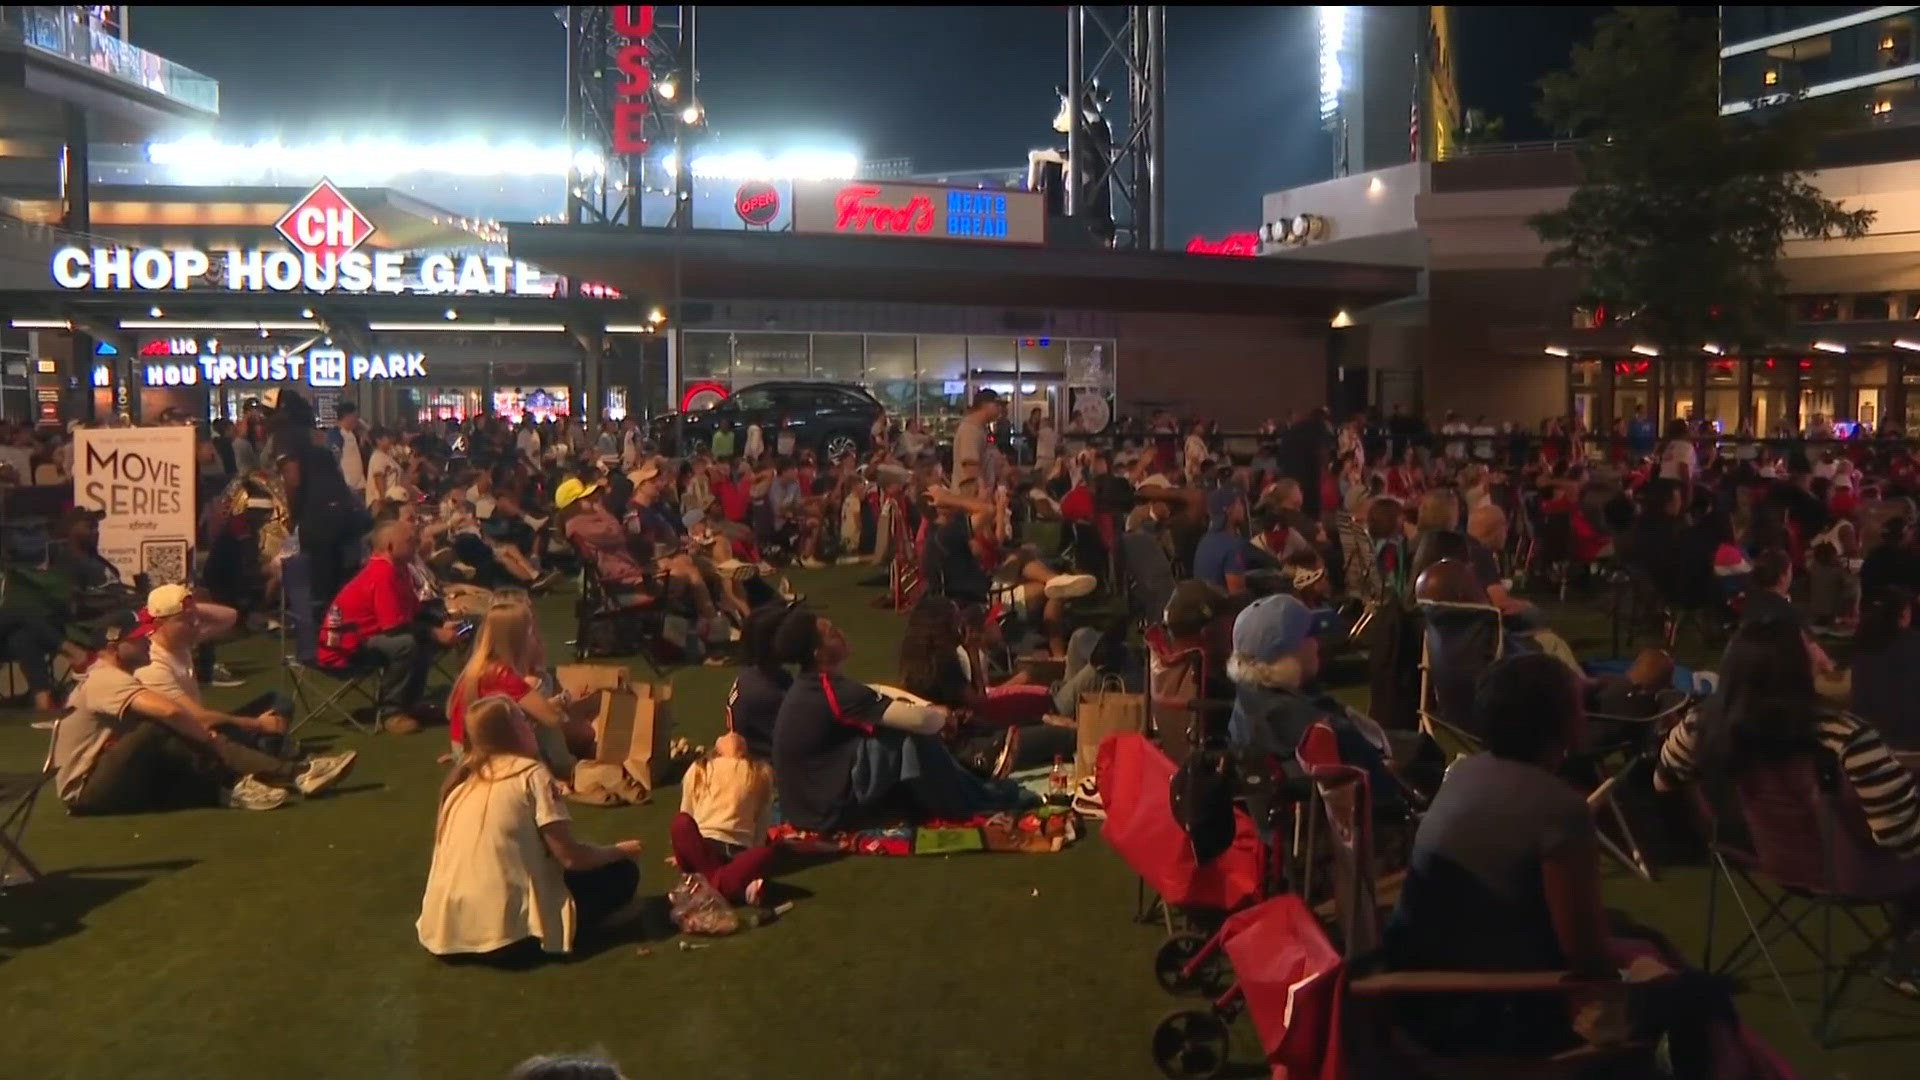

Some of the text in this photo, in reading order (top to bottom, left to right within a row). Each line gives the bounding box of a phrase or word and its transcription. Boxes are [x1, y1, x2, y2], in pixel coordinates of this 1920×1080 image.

[742, 191, 775, 214] OPEN
[834, 183, 936, 236] Fred's
[947, 190, 992, 214] MEAT
[297, 207, 354, 247] CH
[947, 213, 1008, 239] BREAD
[52, 247, 544, 294] CHOP HOUSE GATE
[170, 337, 217, 355] LIGT
[198, 353, 427, 382] TRUIST PARK
[86, 440, 181, 489] MOVIE
[85, 481, 181, 516] SERIES
